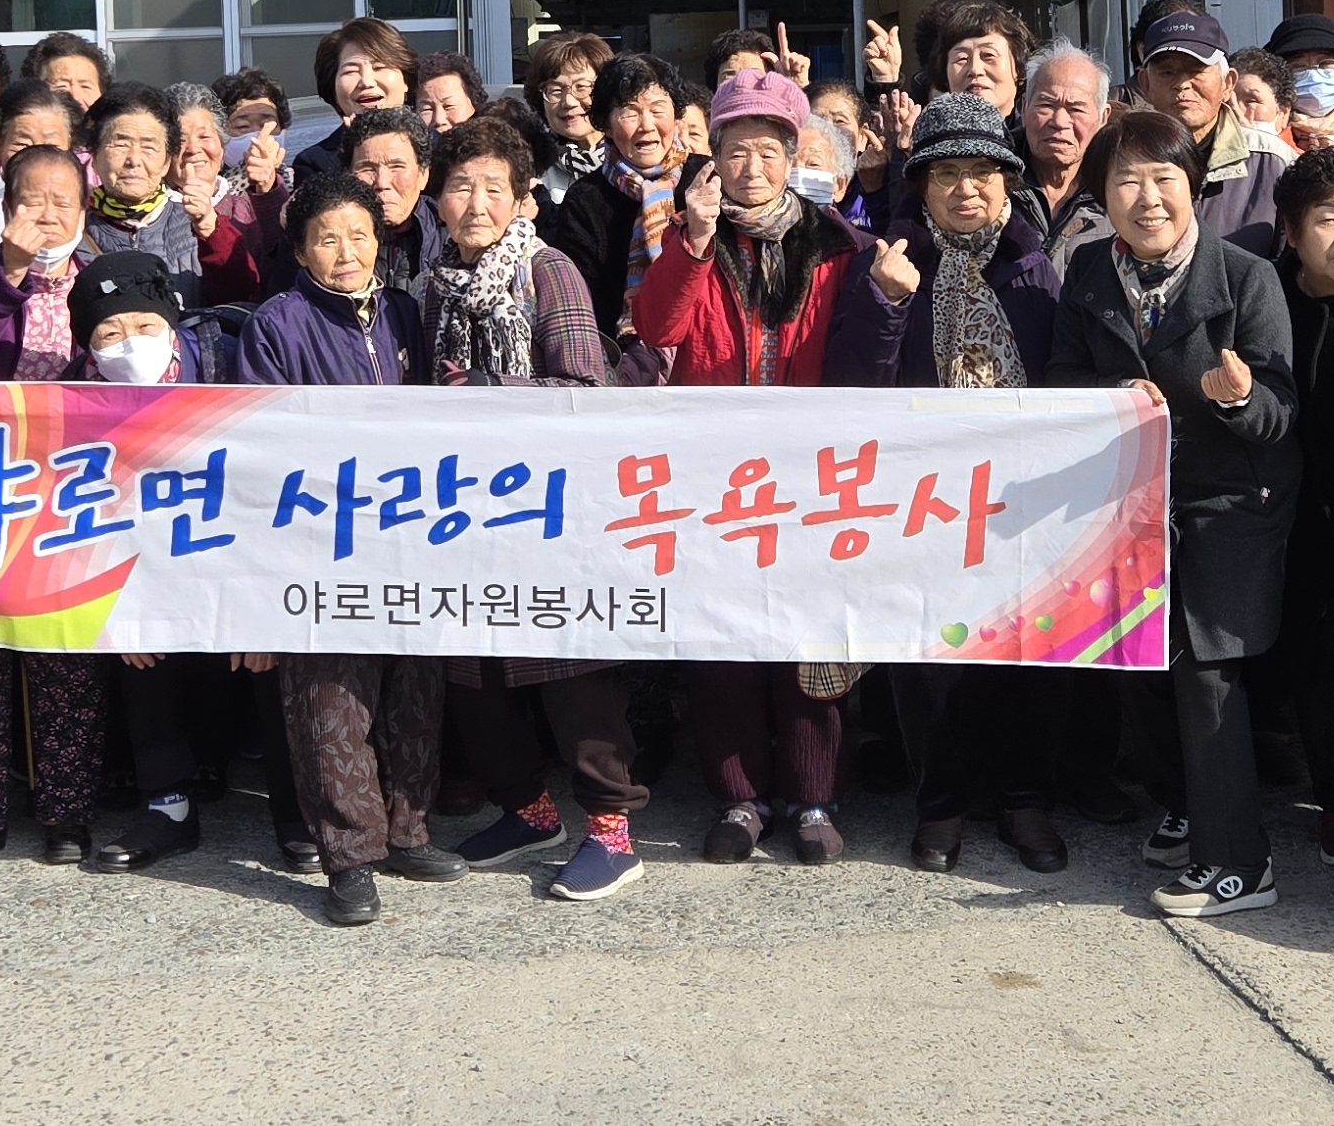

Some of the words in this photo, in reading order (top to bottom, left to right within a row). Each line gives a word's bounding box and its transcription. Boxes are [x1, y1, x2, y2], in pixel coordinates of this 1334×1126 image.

[272, 454, 567, 561] 사랑의
[604, 439, 1006, 576] 목욕봉사
[283, 580, 668, 633] 야로면자원봉사회
